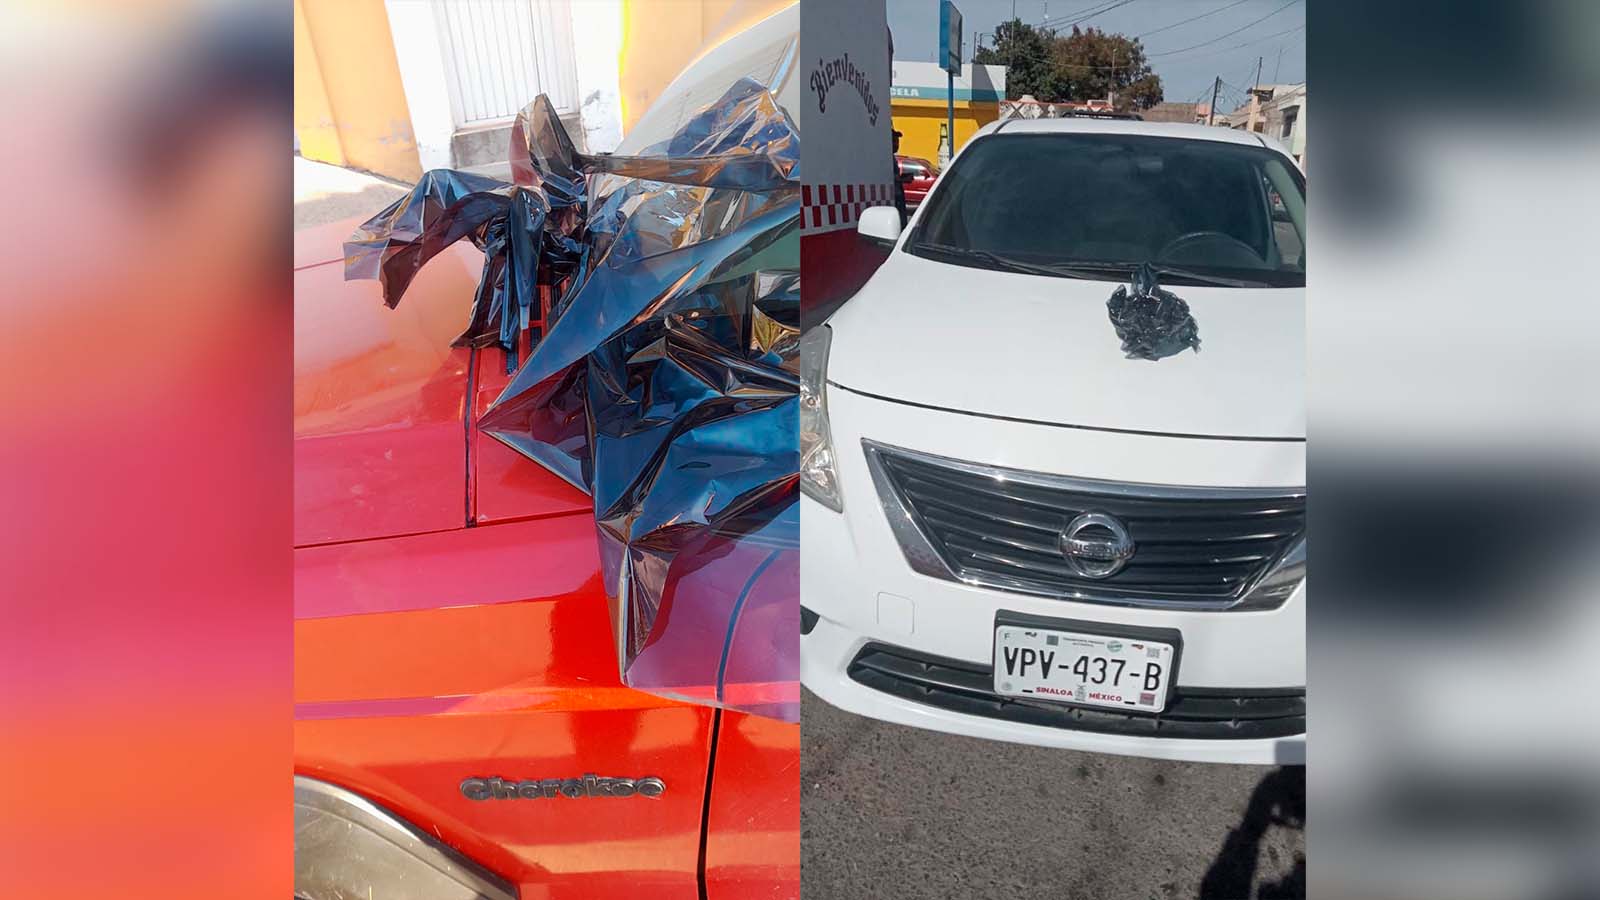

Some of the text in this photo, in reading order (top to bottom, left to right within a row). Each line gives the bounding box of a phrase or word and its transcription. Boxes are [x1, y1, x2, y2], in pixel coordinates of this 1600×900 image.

[1003, 645, 1162, 692] VPV-437-B
[1035, 686, 1122, 702] SINALOA MÉXICO
